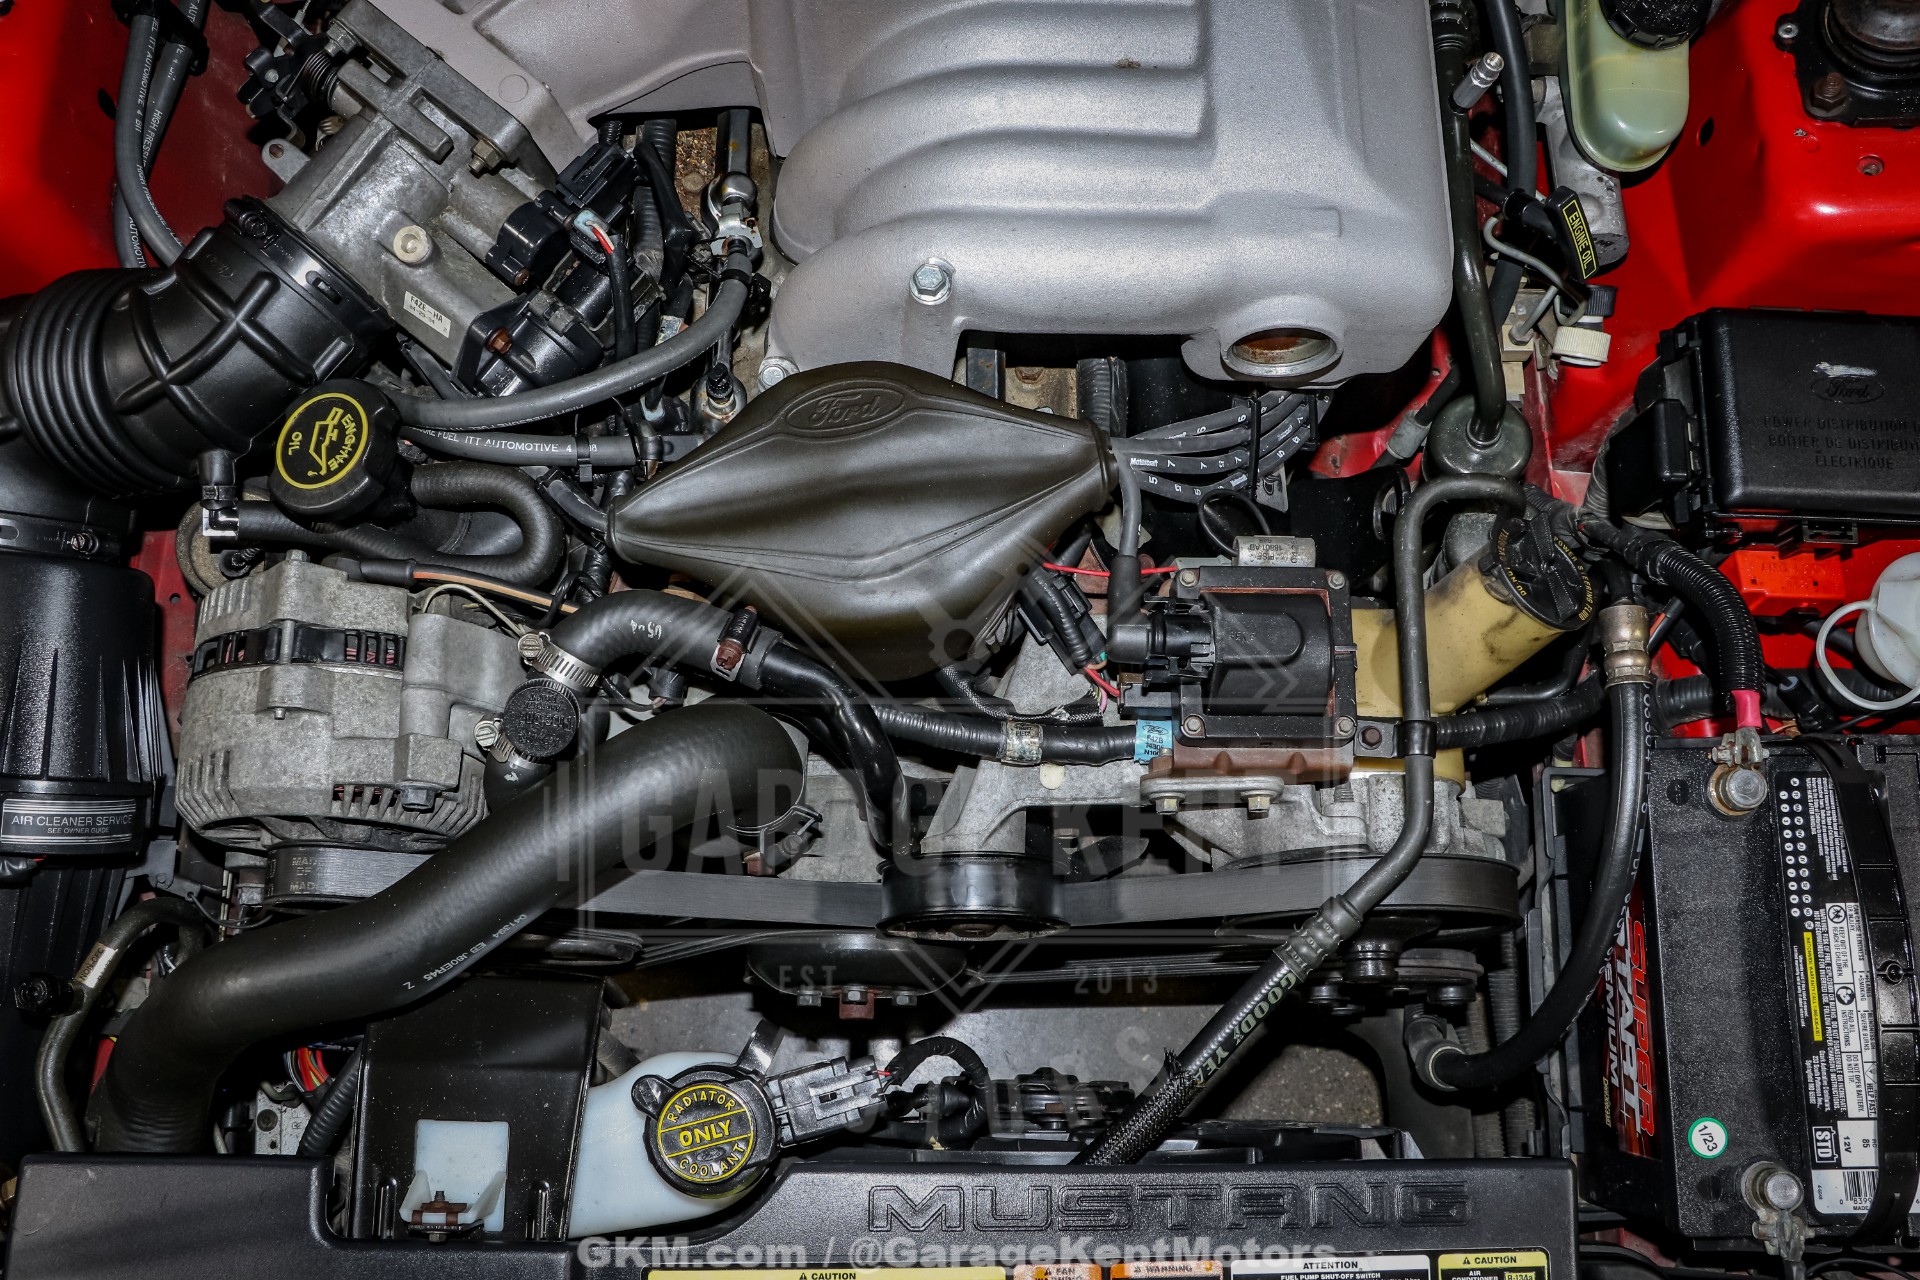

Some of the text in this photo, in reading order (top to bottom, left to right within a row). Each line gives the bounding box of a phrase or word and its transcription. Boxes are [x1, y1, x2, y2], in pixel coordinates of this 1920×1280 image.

[137, 52, 153, 107] AUTOMOTIVE
[149, 109, 162, 131] HIGH
[1569, 211, 1593, 269] ENGINE OIL
[810, 394, 880, 427] Ford
[288, 431, 302, 456] OIL
[328, 413, 357, 471] ENGINE
[484, 438, 558, 452] AUTOMOTIVE
[1553, 535, 1578, 561] POWER
[11, 814, 133, 826] AIR CLEANER SERVICE
[91, 826, 110, 834] GUIDE
[1835, 952, 1843, 978] CHILDREN.
[1631, 920, 1654, 1136] SUPER
[667, 1090, 736, 1122] RADIATOR
[679, 1120, 731, 1147] ONLY
[1698, 1124, 1718, 1152] 1/23
[1816, 1131, 1832, 1157] STD
[1863, 1139, 1870, 1148] 85
[680, 1143, 745, 1176] COOLANT
[868, 1182, 1471, 1232] MUSTANG
[1146, 1265, 1193, 1273] WARNING
[1303, 1261, 1358, 1270] ATTENTION
[1474, 1256, 1517, 1265] CAUTION
[811, 1272, 857, 1280] CAUTION
